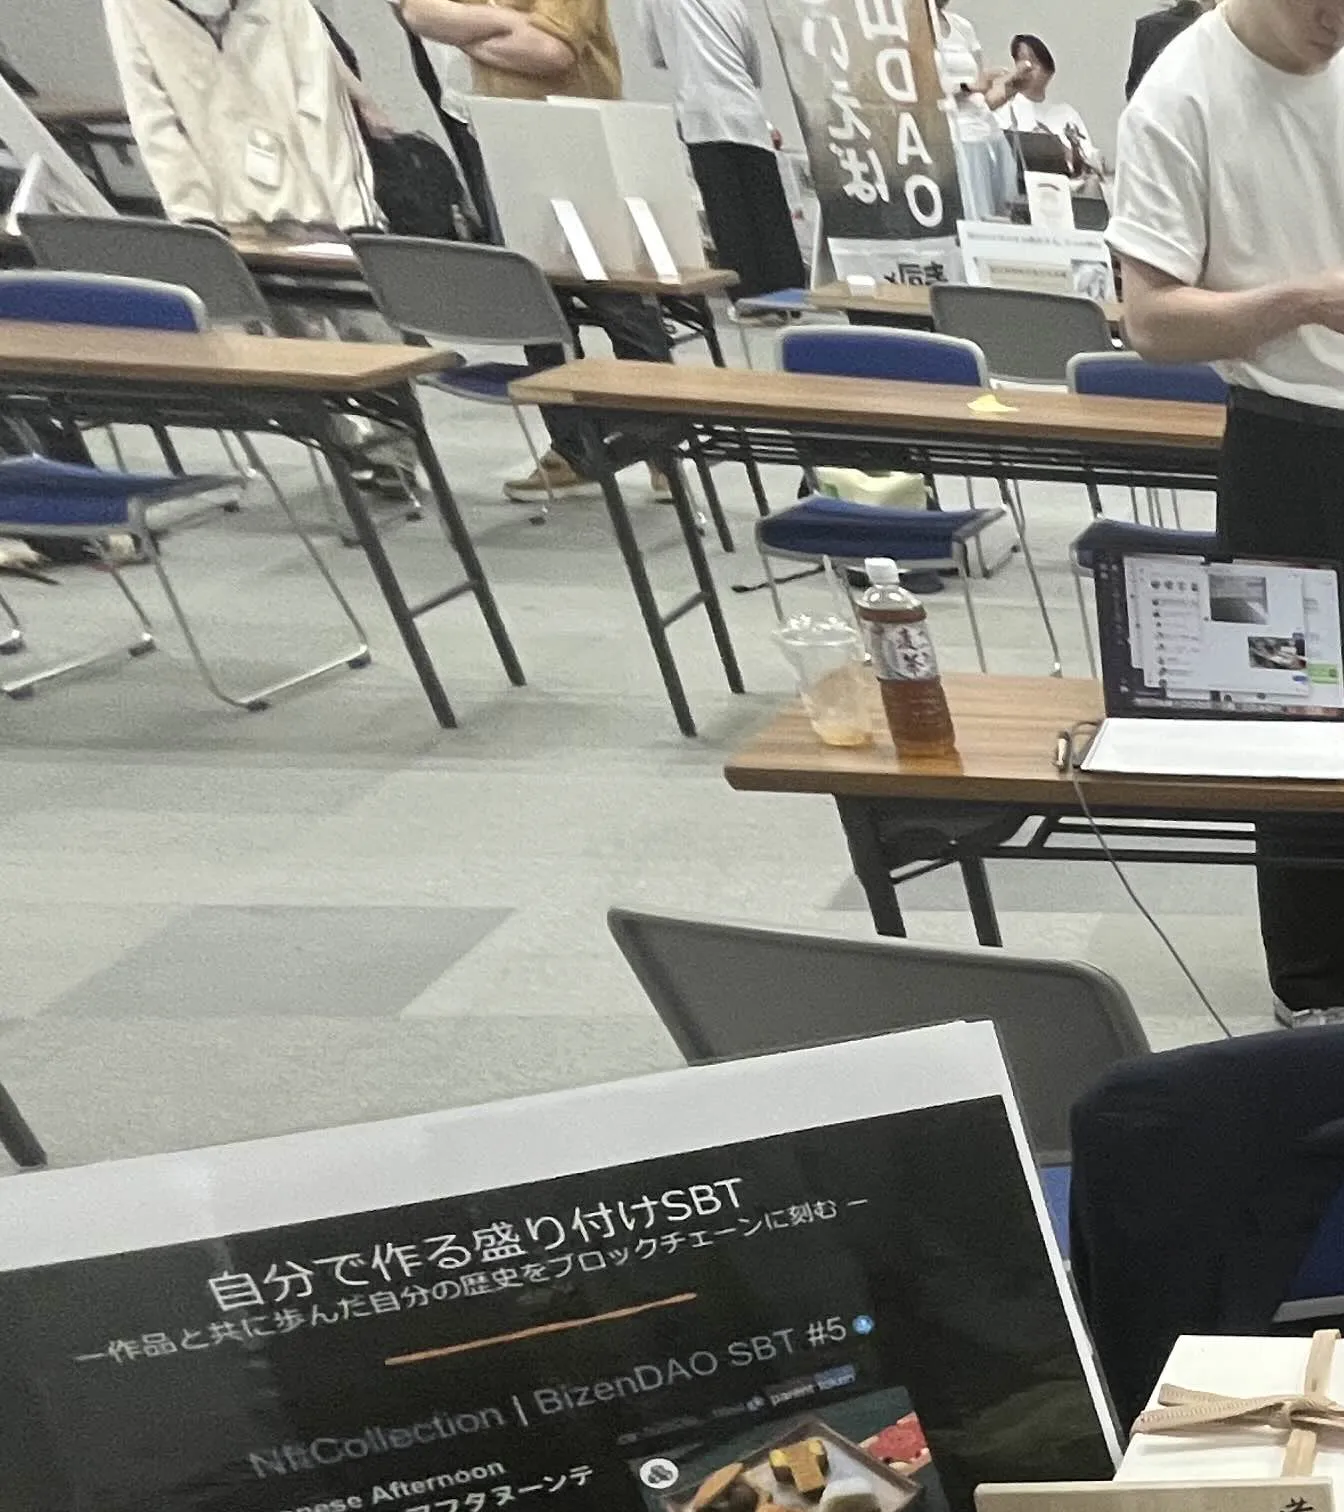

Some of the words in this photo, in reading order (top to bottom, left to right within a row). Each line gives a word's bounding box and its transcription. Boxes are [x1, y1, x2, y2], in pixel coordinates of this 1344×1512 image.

[207, 1176, 744, 1312] 自分で作る盛り付けSBT
[533, 1350, 719, 1416] BizenDAO
[727, 1328, 796, 1368] SBT
[807, 1316, 848, 1349] #5
[371, 1460, 507, 1505] Afternoon
